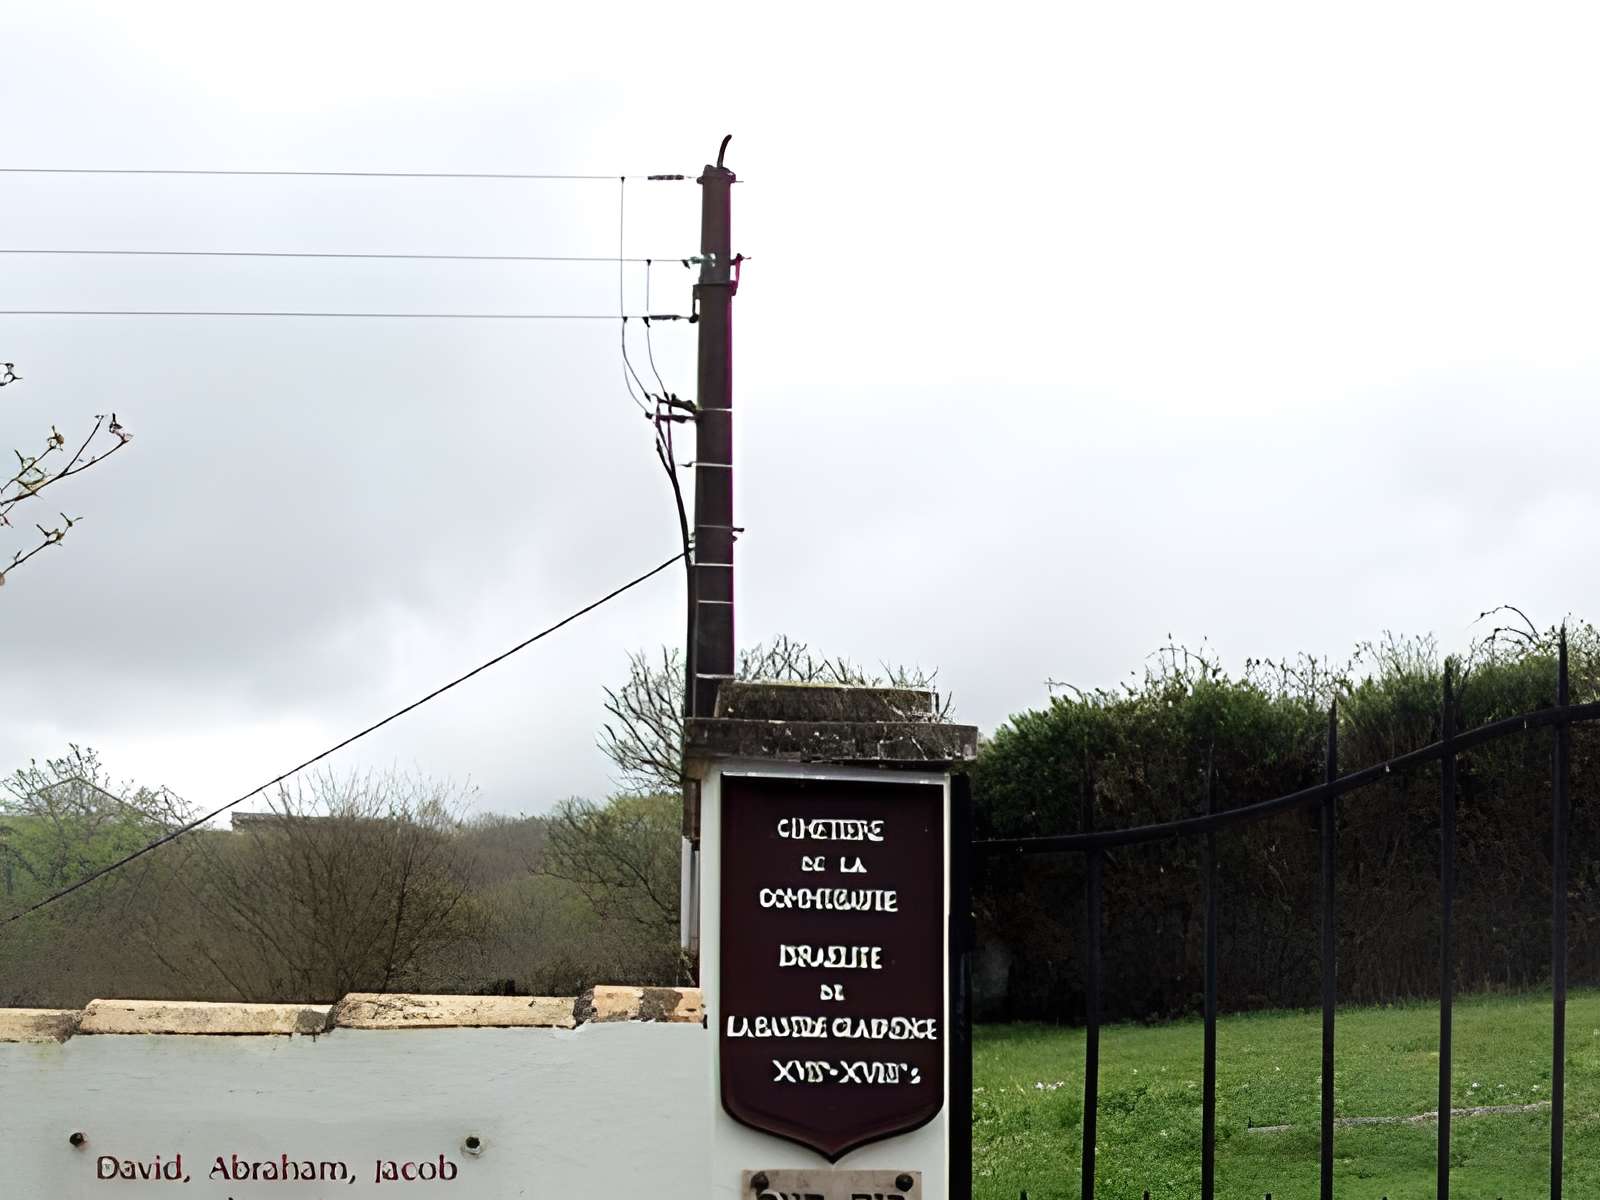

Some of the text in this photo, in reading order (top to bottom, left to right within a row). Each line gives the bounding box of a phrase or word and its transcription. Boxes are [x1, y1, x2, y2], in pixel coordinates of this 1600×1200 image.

[840, 856, 868, 873] LA
[96, 1153, 459, 1185] David, Abraham, Jacob
